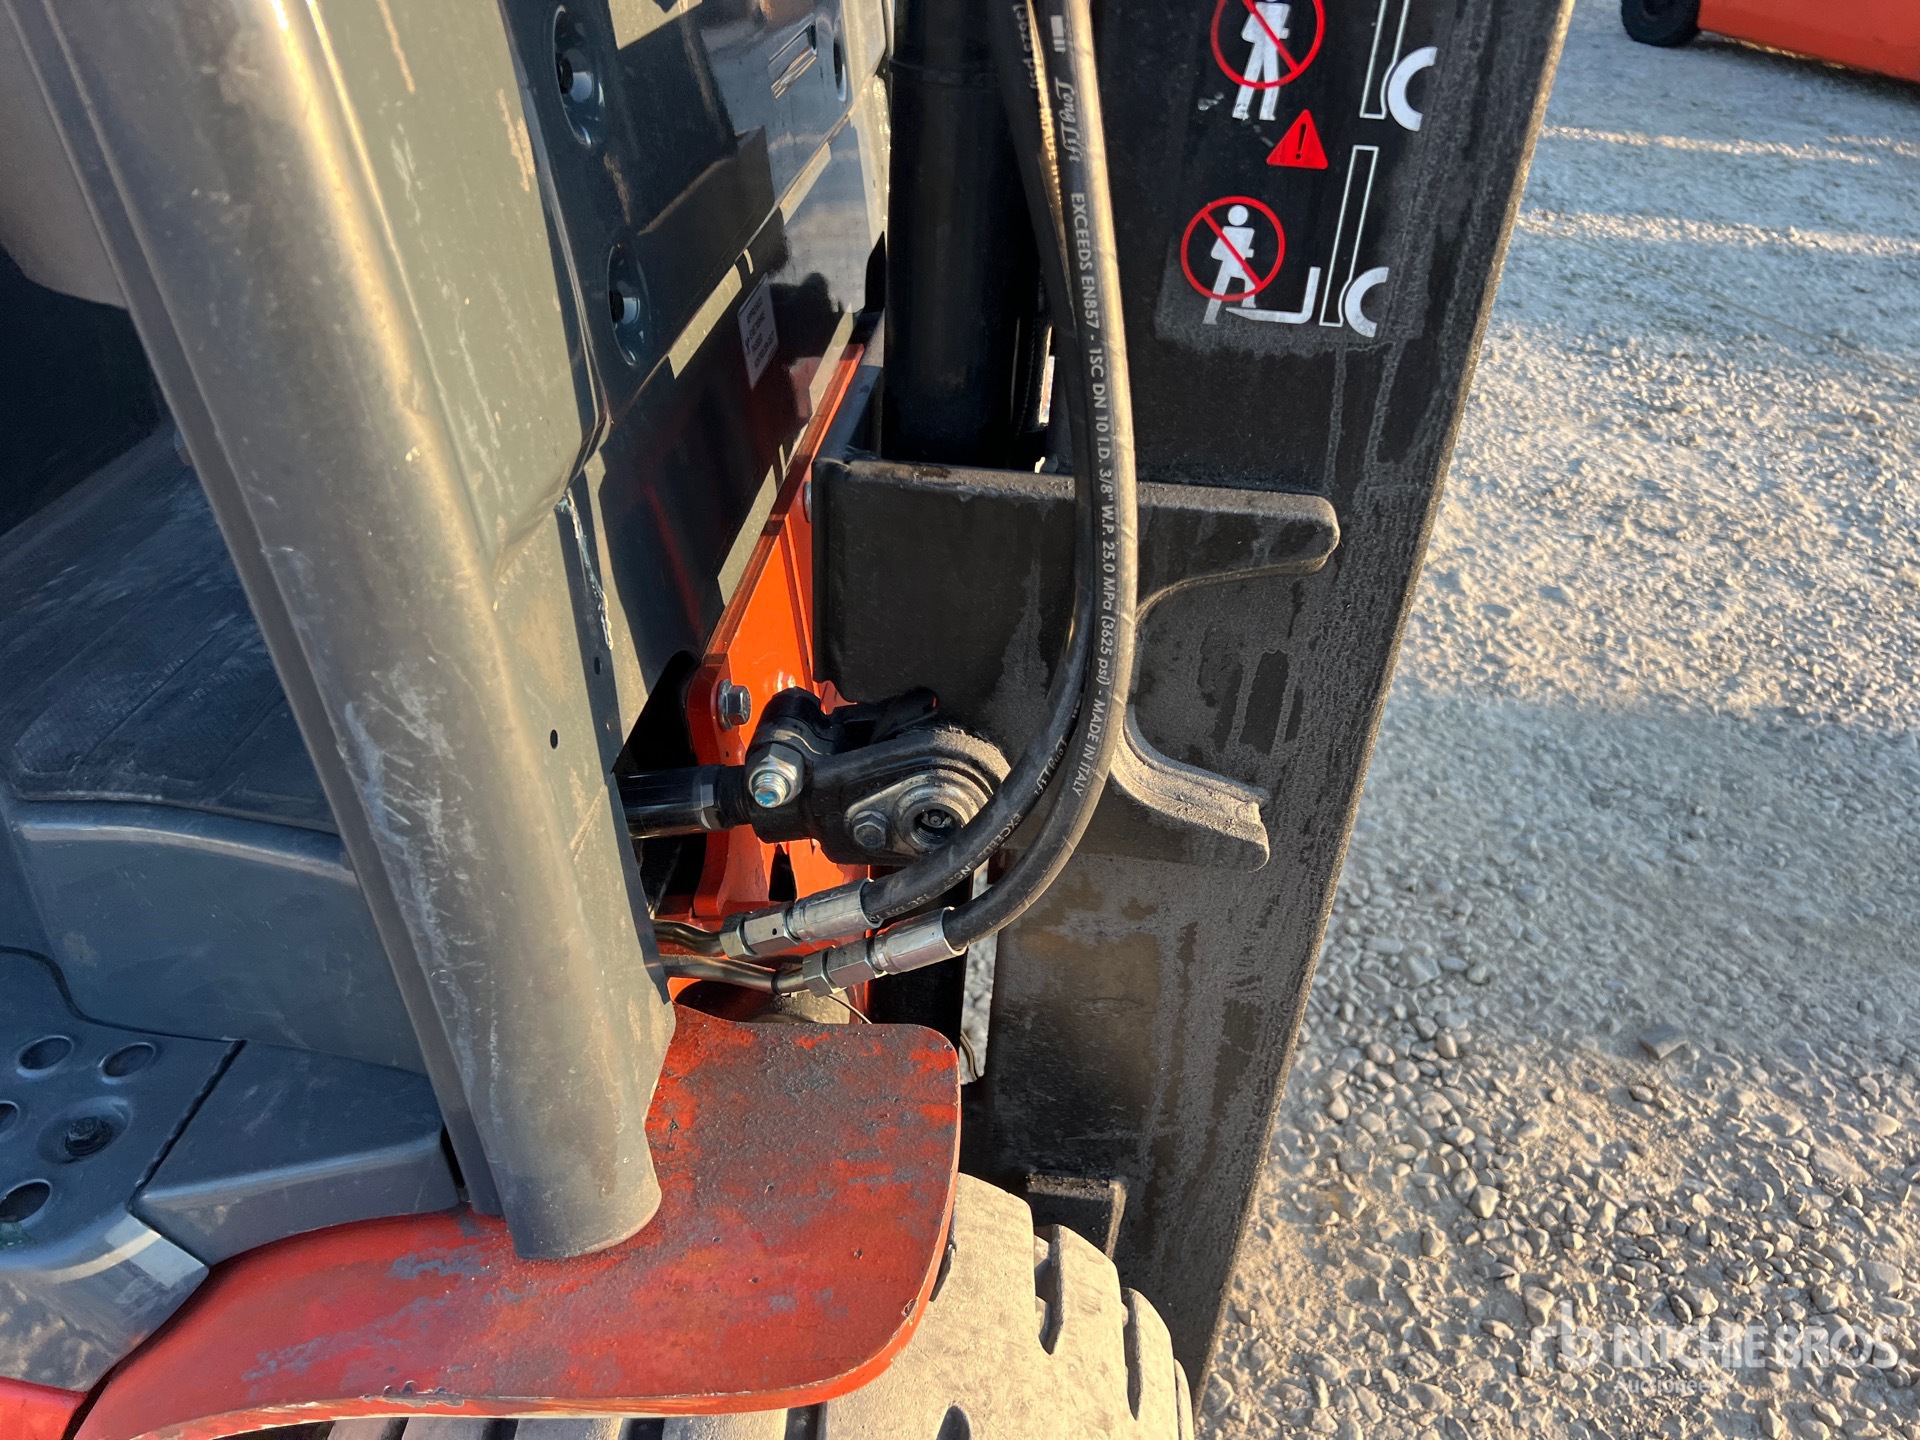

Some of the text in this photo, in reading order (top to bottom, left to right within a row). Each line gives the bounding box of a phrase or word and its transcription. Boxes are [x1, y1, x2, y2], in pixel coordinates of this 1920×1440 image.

[1071, 192, 1093, 271] EXCEEDS
[1081, 276, 1100, 329] EN857
[1089, 348, 1104, 378] 1SC
[1092, 383, 1107, 409] DN
[1095, 415, 1109, 433] 10
[1097, 437, 1111, 463] I.D.
[1099, 469, 1114, 501] 3/8"
[1101, 505, 1115, 536] W.P.
[1103, 577, 1116, 611] MPa
[1099, 615, 1116, 656] (3625
[1096, 658, 1110, 686] psi)
[1087, 699, 1106, 743] MADE
[1082, 743, 1097, 761] IN
[1072, 761, 1091, 797] ITALY
